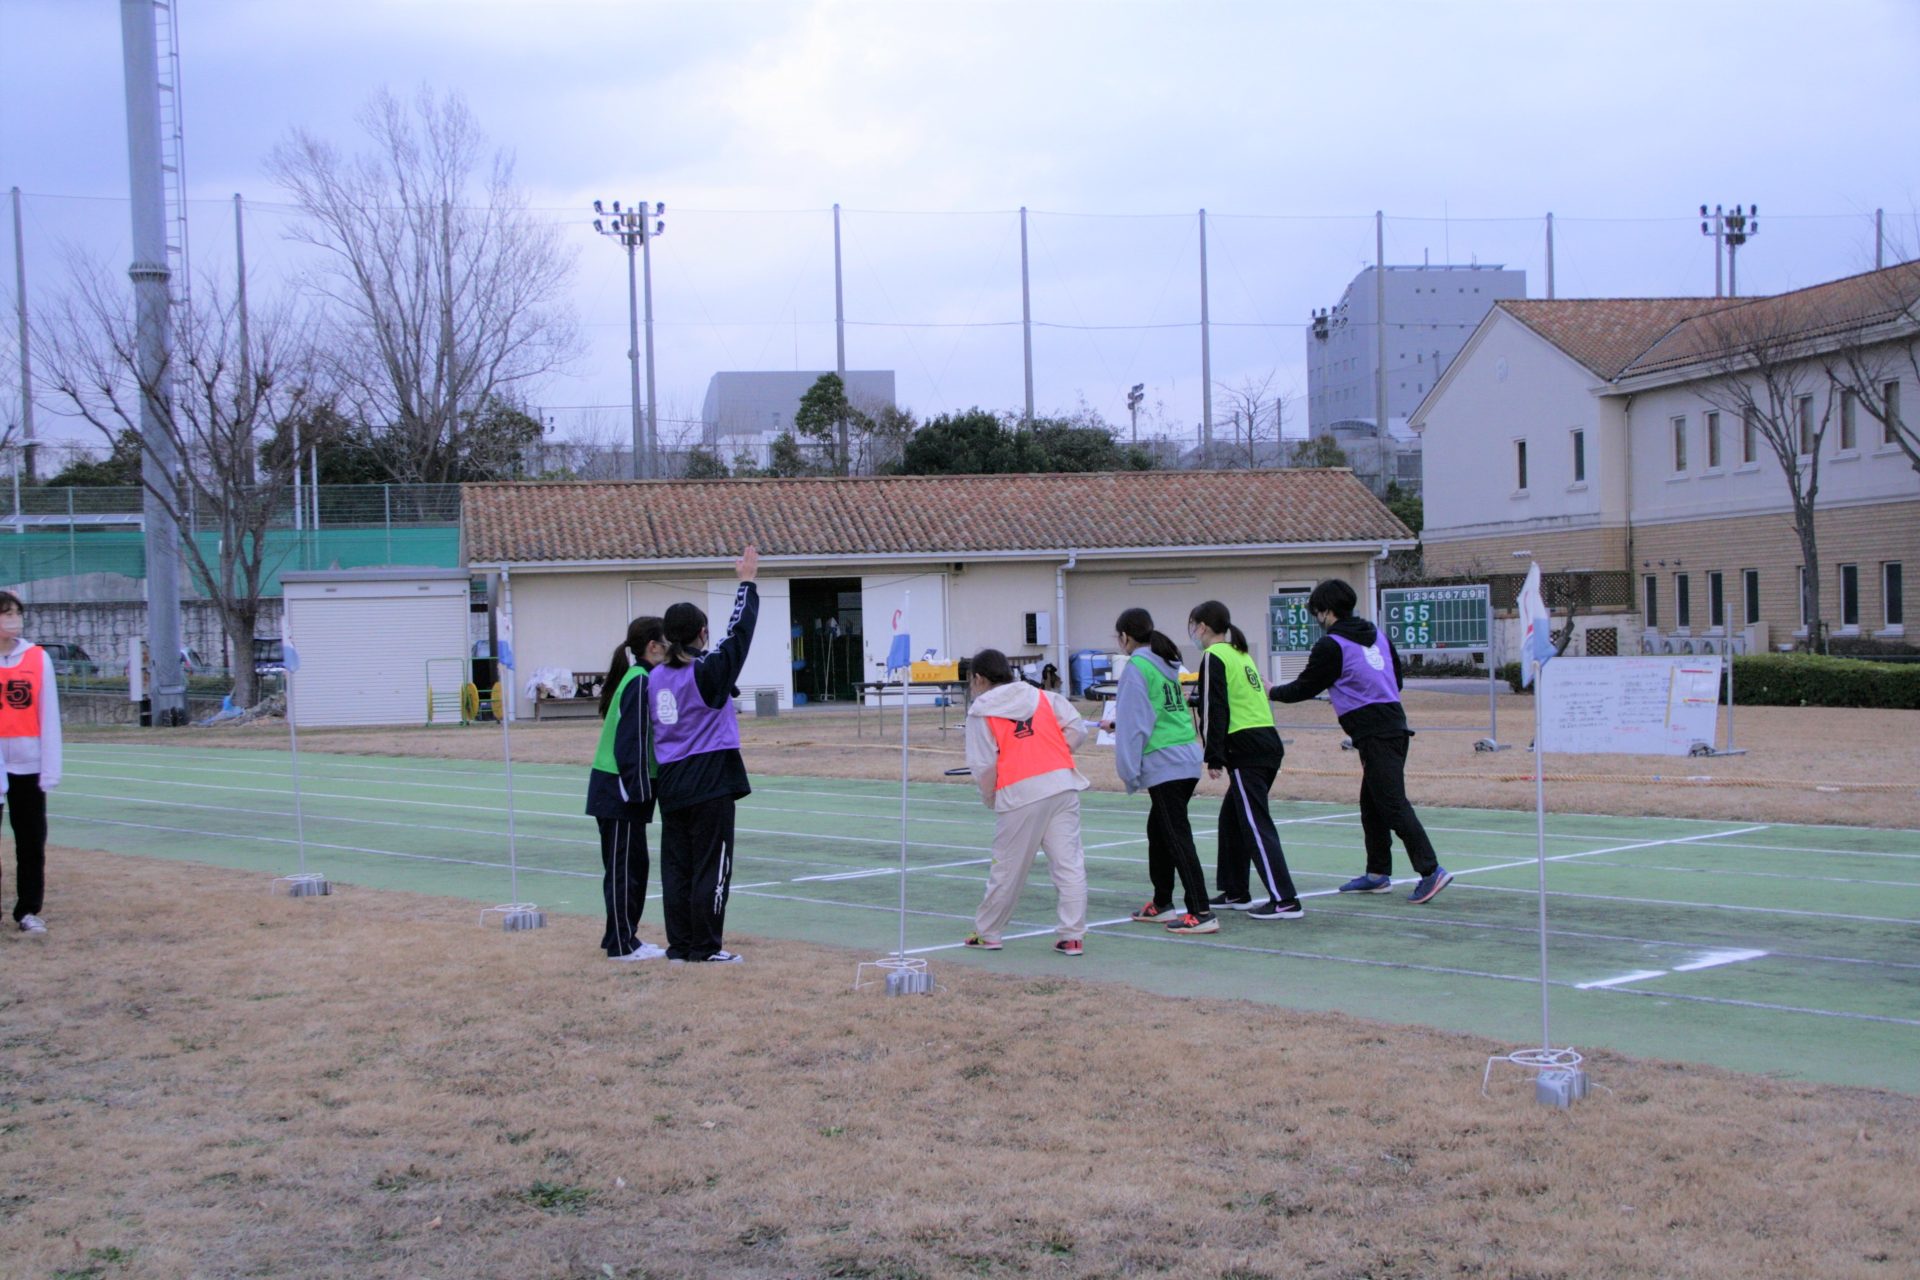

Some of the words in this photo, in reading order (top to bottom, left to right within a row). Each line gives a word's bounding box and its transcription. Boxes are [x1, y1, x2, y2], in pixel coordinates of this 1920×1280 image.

[1275, 609, 1283, 623] A
[1390, 607, 1400, 619] C
[1277, 627, 1284, 641] B
[1390, 626, 1399, 639] D
[1245, 665, 1261, 692] 6
[0, 680, 33, 710] 5
[1162, 683, 1185, 712] 11
